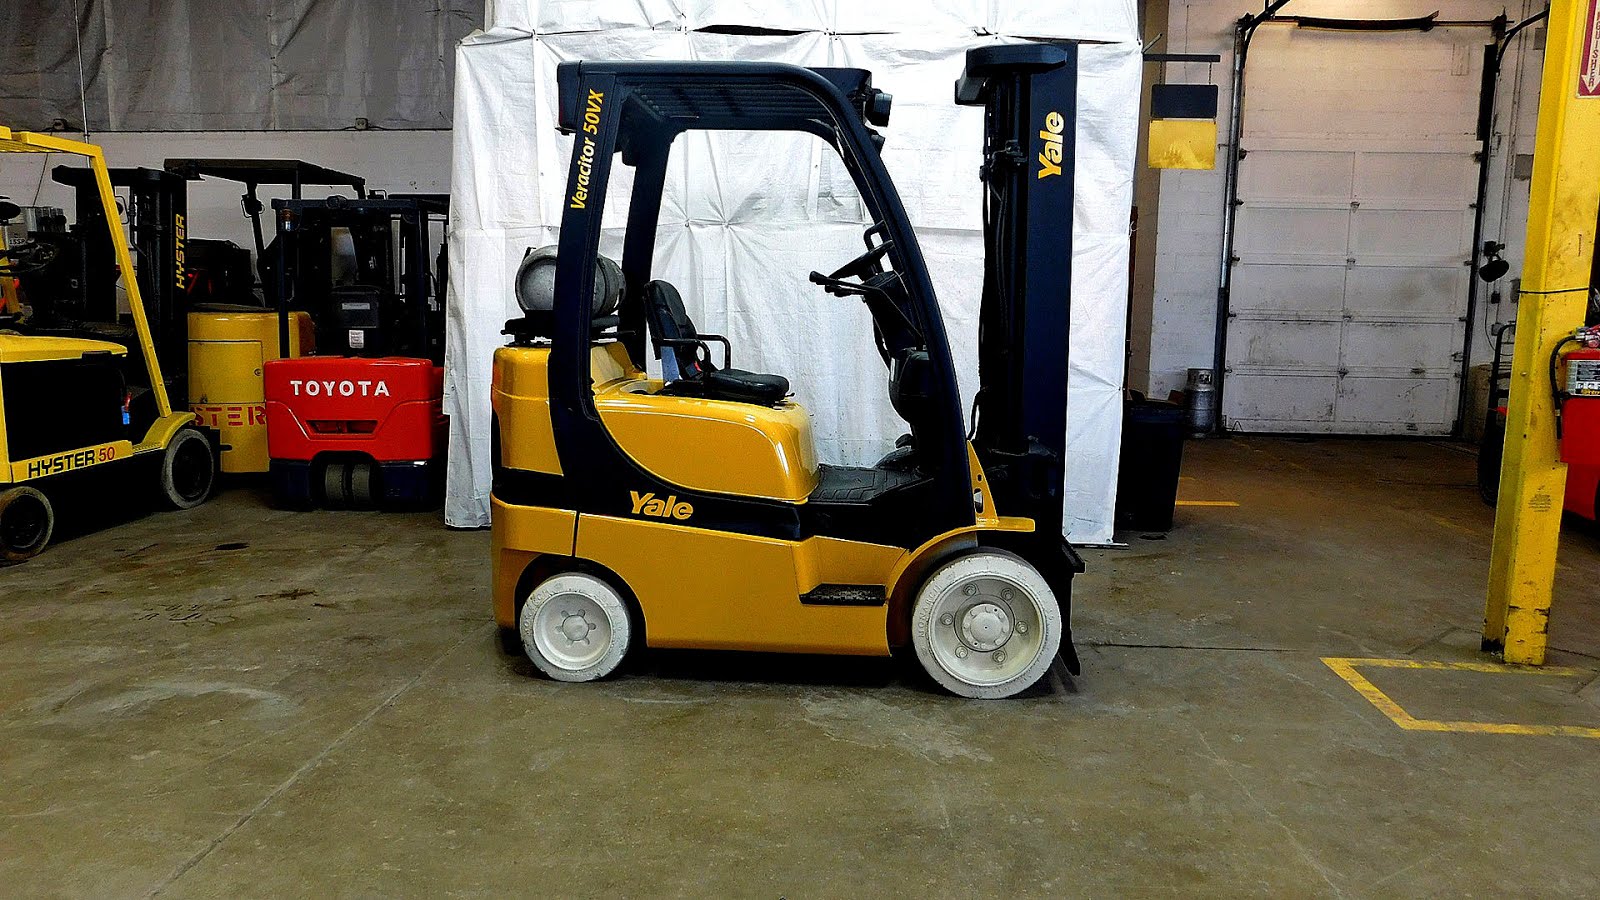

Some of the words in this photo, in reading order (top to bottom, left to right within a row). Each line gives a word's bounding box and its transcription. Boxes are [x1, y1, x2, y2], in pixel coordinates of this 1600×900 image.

[570, 137, 596, 209] Veracitor
[583, 88, 604, 135] 50VX
[1038, 111, 1064, 179] Yale
[175, 213, 185, 289] HYSTER
[290, 380, 390, 396] TOYOTA
[28, 450, 95, 478] HYSTER
[99, 447, 115, 462] 50
[630, 490, 694, 520] Yale
